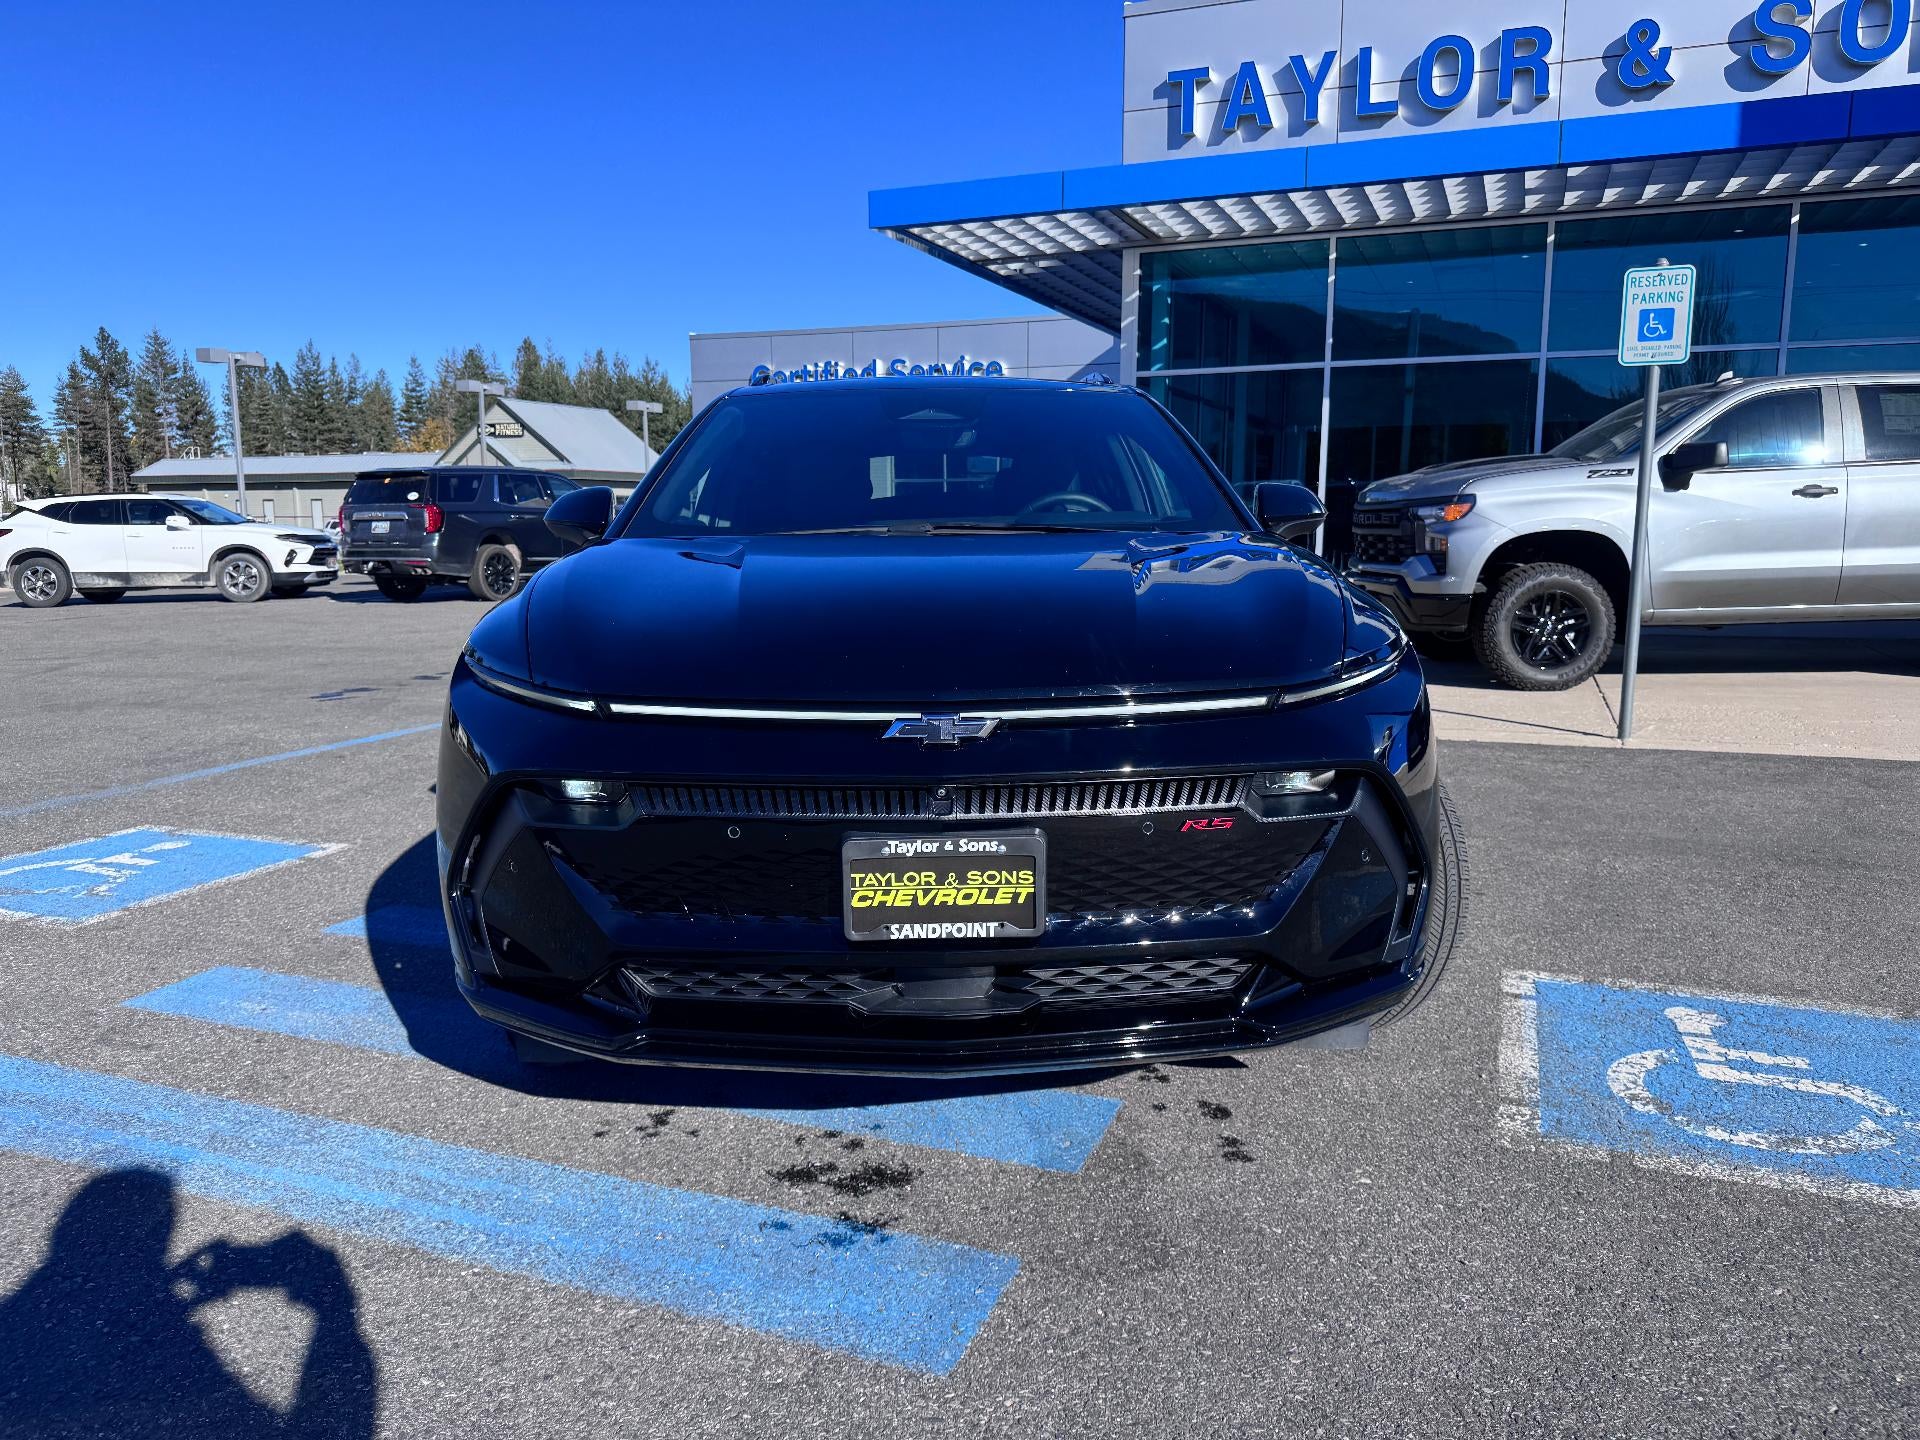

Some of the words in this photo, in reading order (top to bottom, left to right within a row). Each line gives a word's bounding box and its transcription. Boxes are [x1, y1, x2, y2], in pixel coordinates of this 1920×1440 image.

[1167, 25, 1553, 137] TAYLOR
[1618, 18, 1675, 89] &
[1630, 273, 1688, 288] RESERVED
[1632, 290, 1684, 305] PARKING
[1180, 817, 1236, 832] RS
[888, 840, 939, 857] Taylor
[944, 841, 954, 852] &
[958, 838, 999, 853] Sons
[851, 871, 937, 888] TAYLOR
[944, 872, 959, 889] &
[966, 870, 1034, 886] SONS
[851, 887, 1035, 908] CHEVROLET
[889, 922, 999, 940] SANDPOINT
